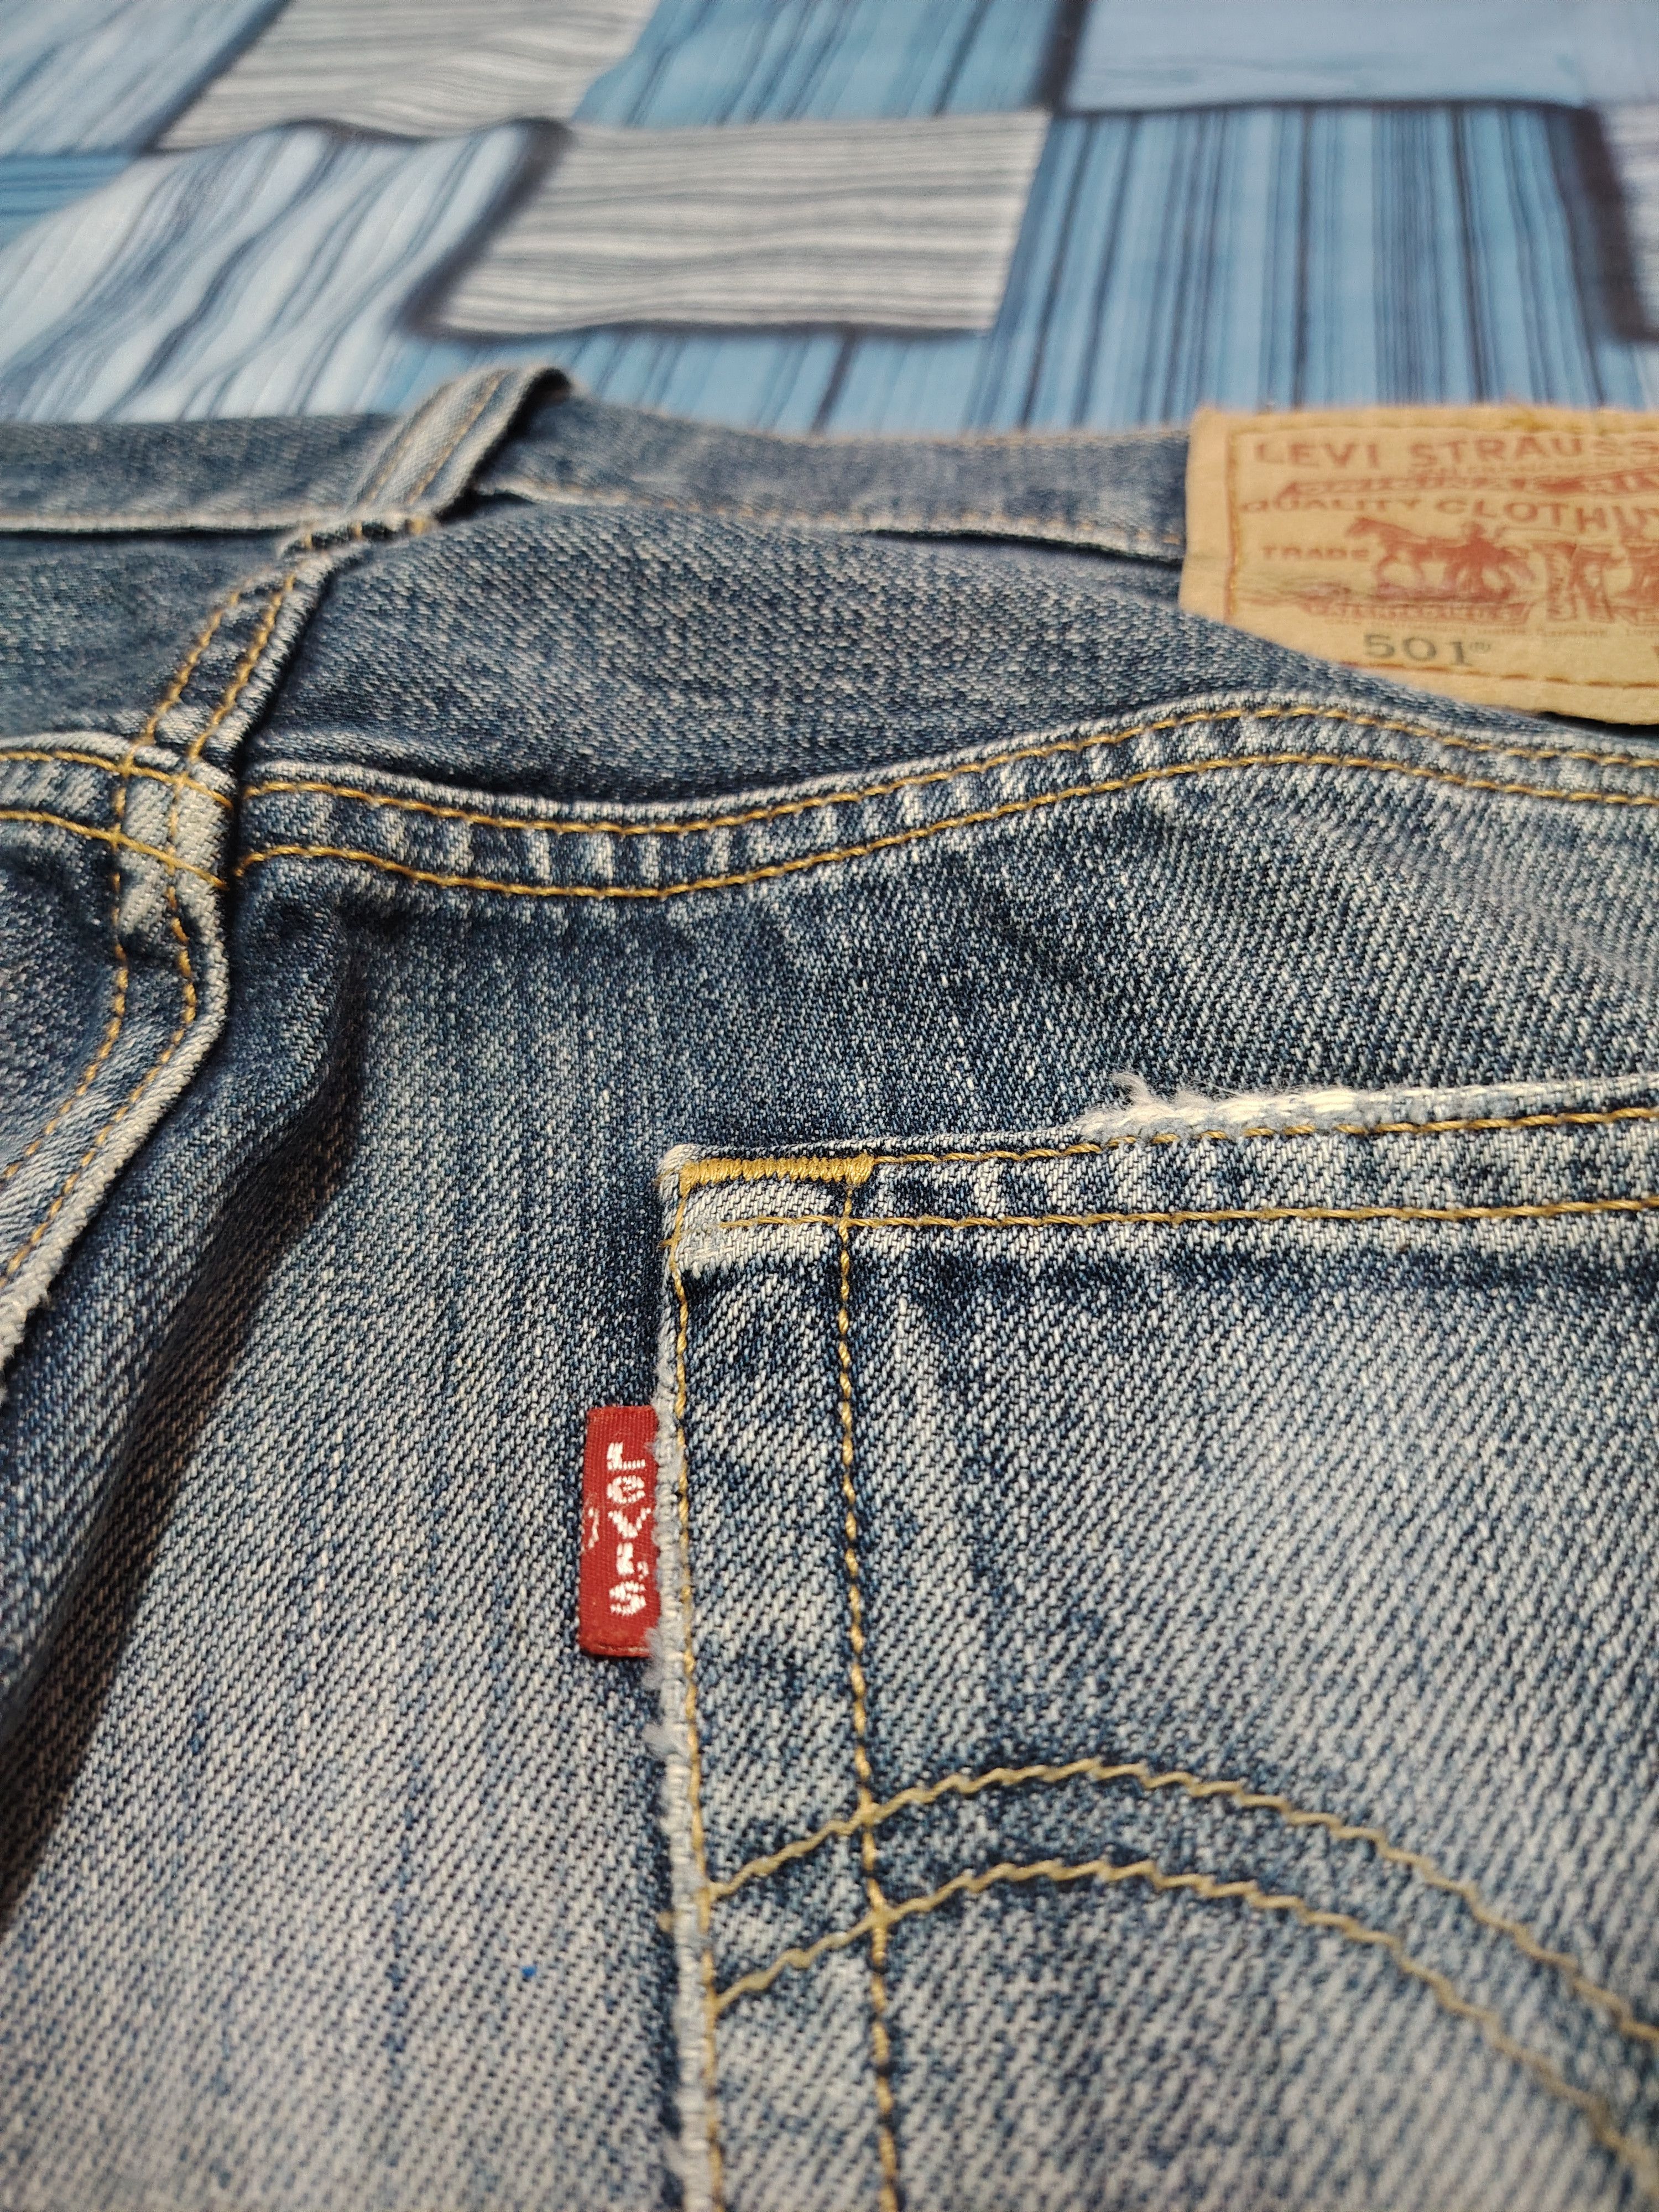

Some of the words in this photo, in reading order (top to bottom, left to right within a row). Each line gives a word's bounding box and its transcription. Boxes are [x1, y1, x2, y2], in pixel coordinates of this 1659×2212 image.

[1254, 442, 1379, 469] LEVI
[1239, 498, 1420, 513] QUALITY
[1260, 546, 1369, 560] TRADE
